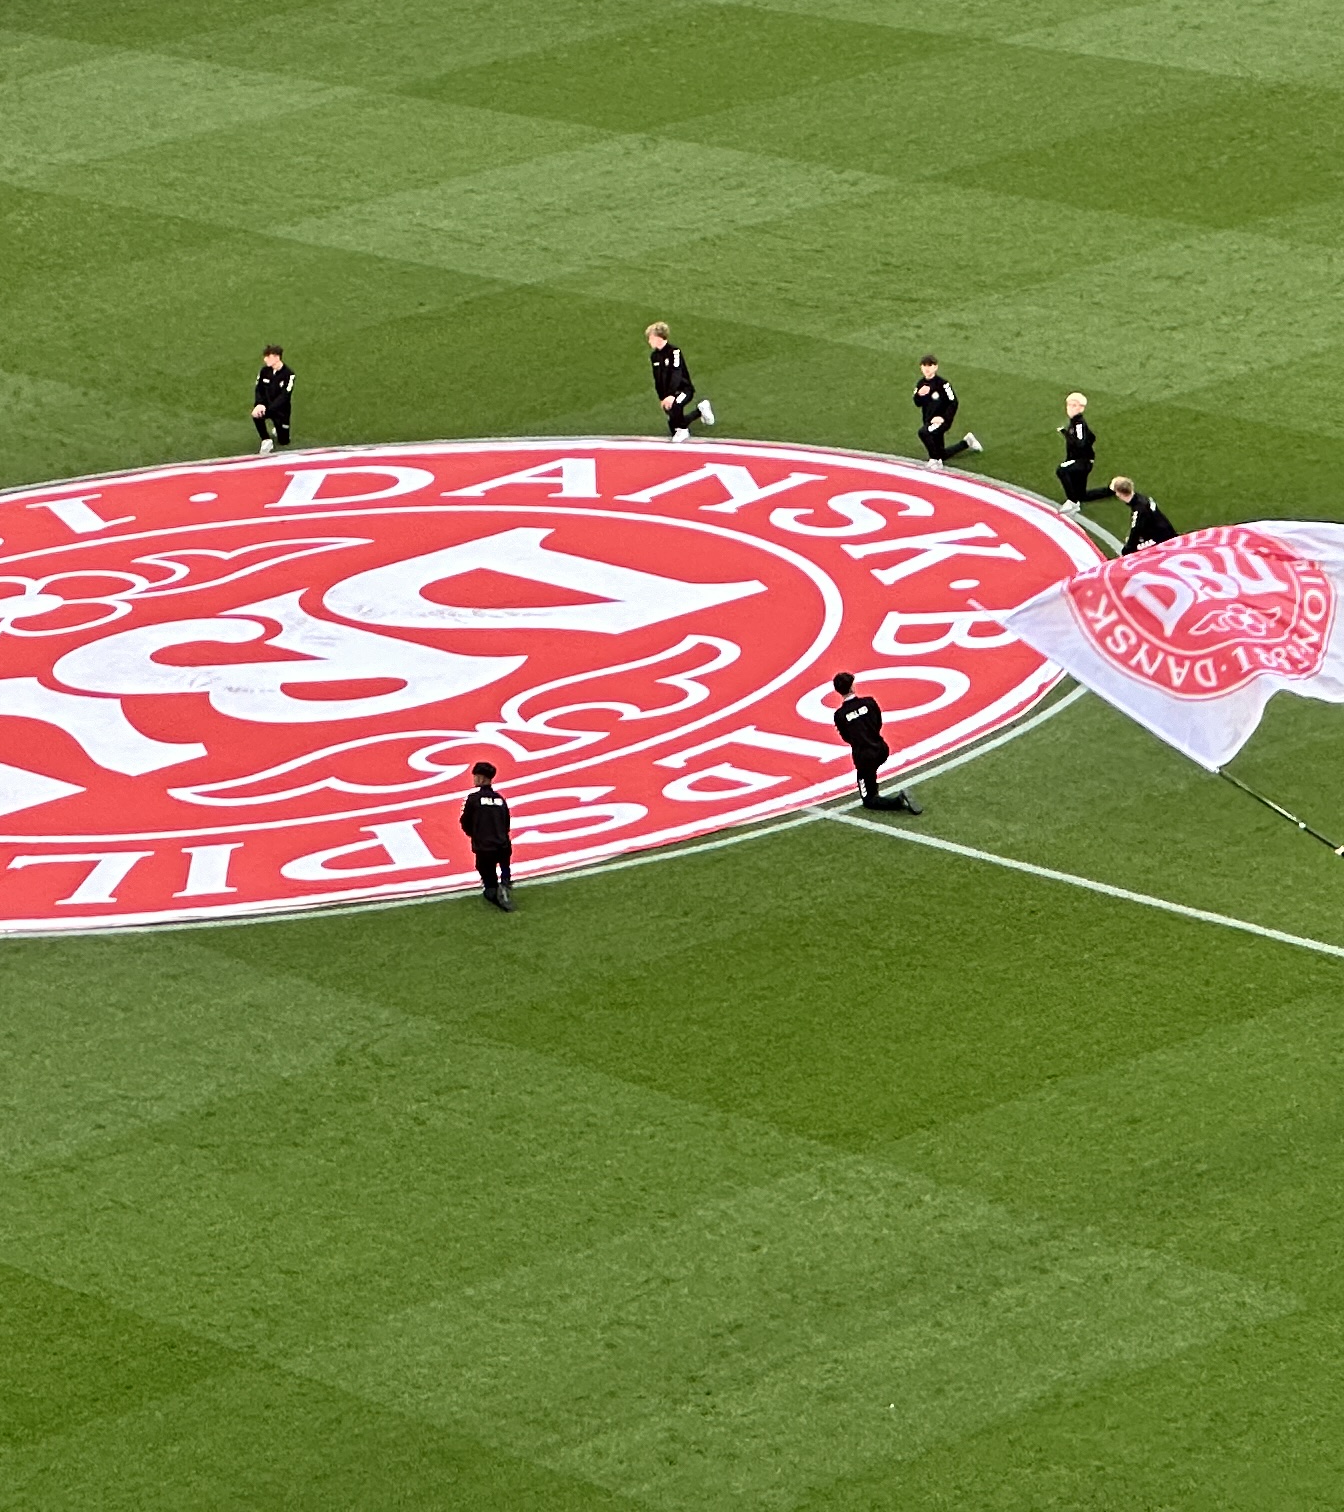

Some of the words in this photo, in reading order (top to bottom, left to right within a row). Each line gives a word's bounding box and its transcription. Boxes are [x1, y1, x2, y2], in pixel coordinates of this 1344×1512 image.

[263, 457, 1026, 585] DANSK
[1120, 545, 1289, 638] DBU
[1084, 593, 1219, 688] DANSK
